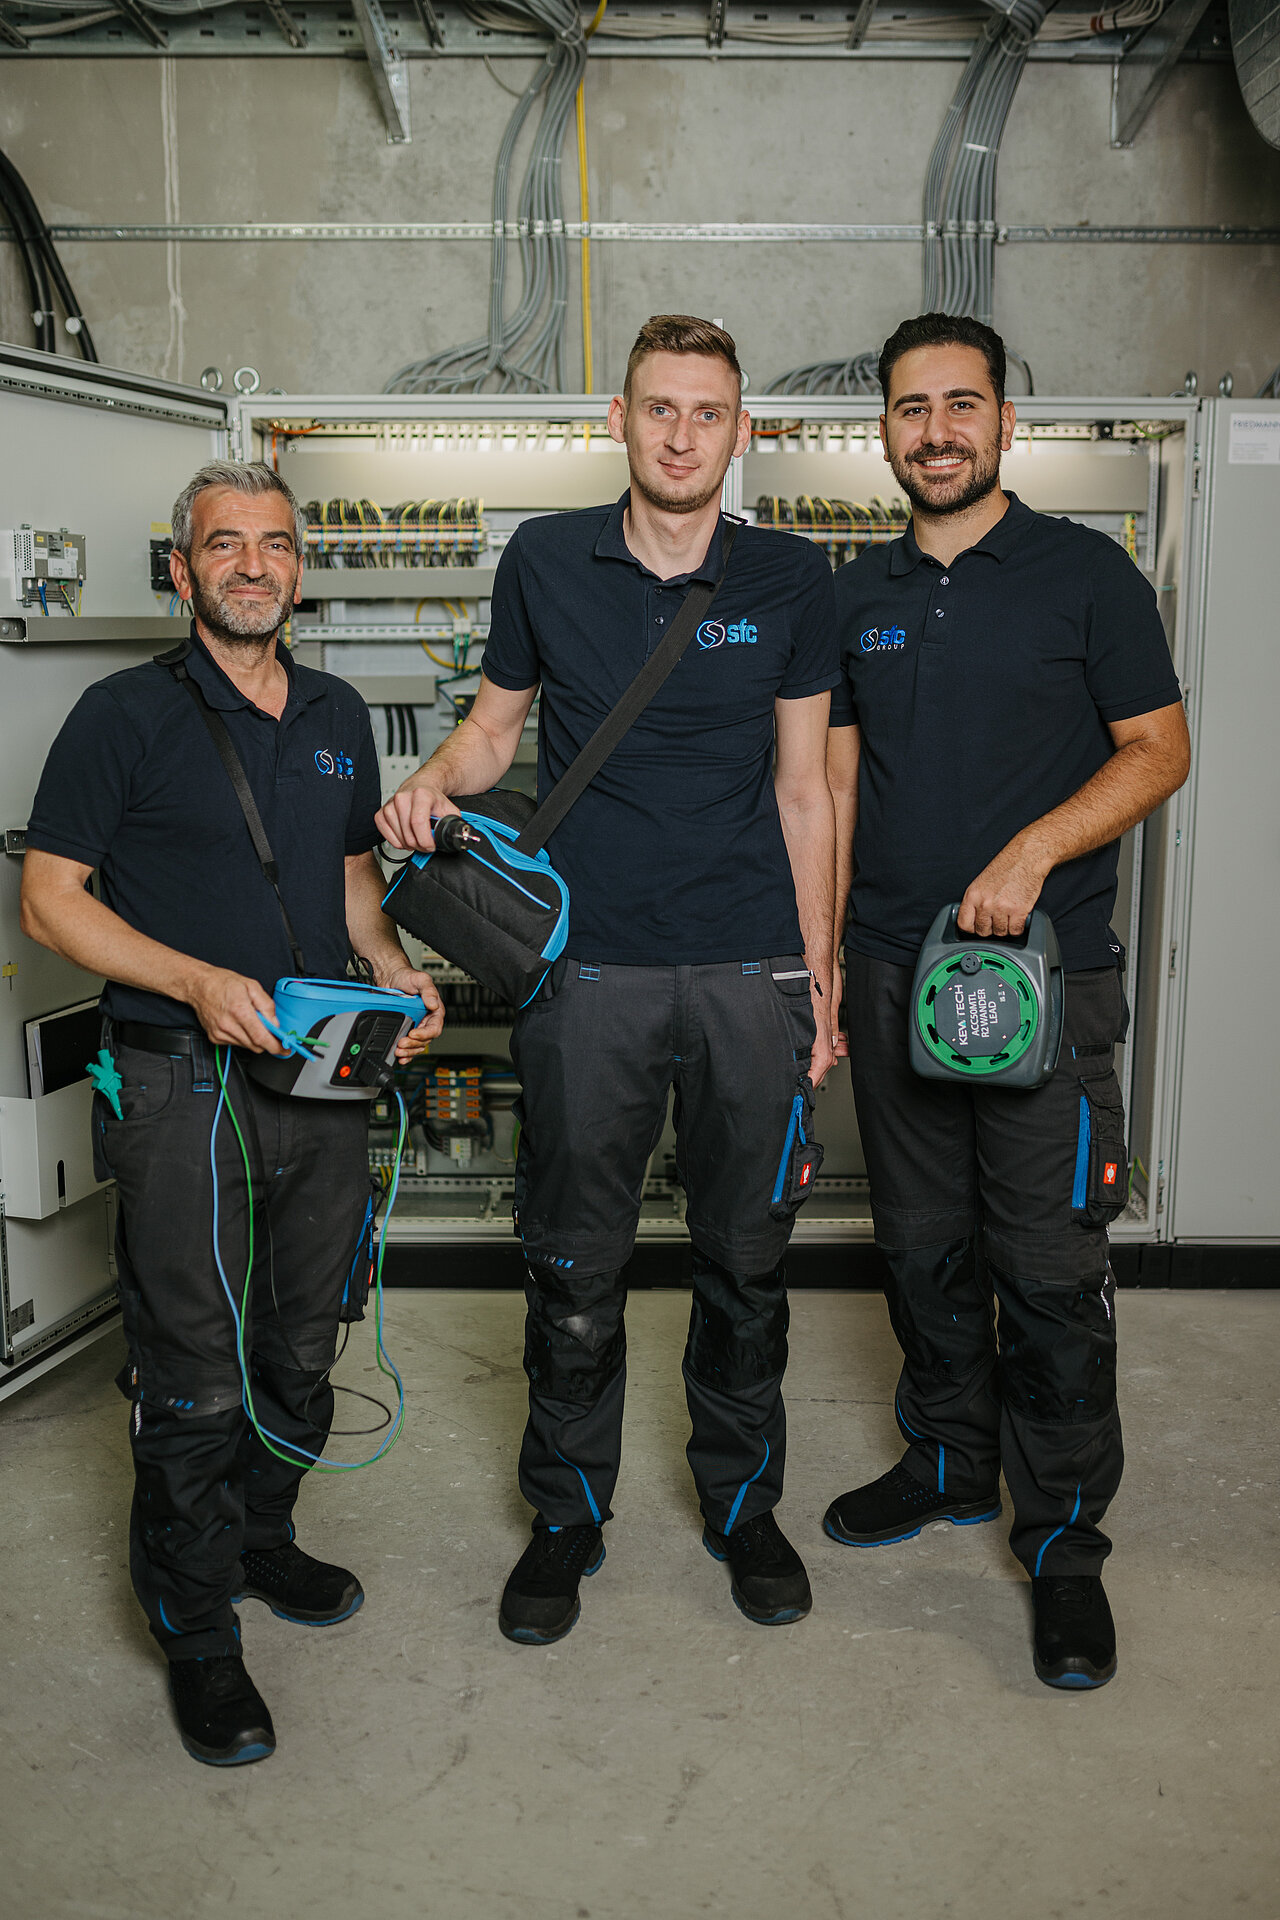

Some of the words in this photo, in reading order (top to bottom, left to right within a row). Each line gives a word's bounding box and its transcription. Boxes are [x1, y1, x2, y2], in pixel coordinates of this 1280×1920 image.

[726, 618, 758, 643] sfc
[879, 624, 906, 645] sfc
[968, 991, 980, 1036] ACC50MTL
[977, 988, 989, 1027] WANDER
[988, 1001, 998, 1024] LEAD
[980, 1027, 990, 1038] R2
